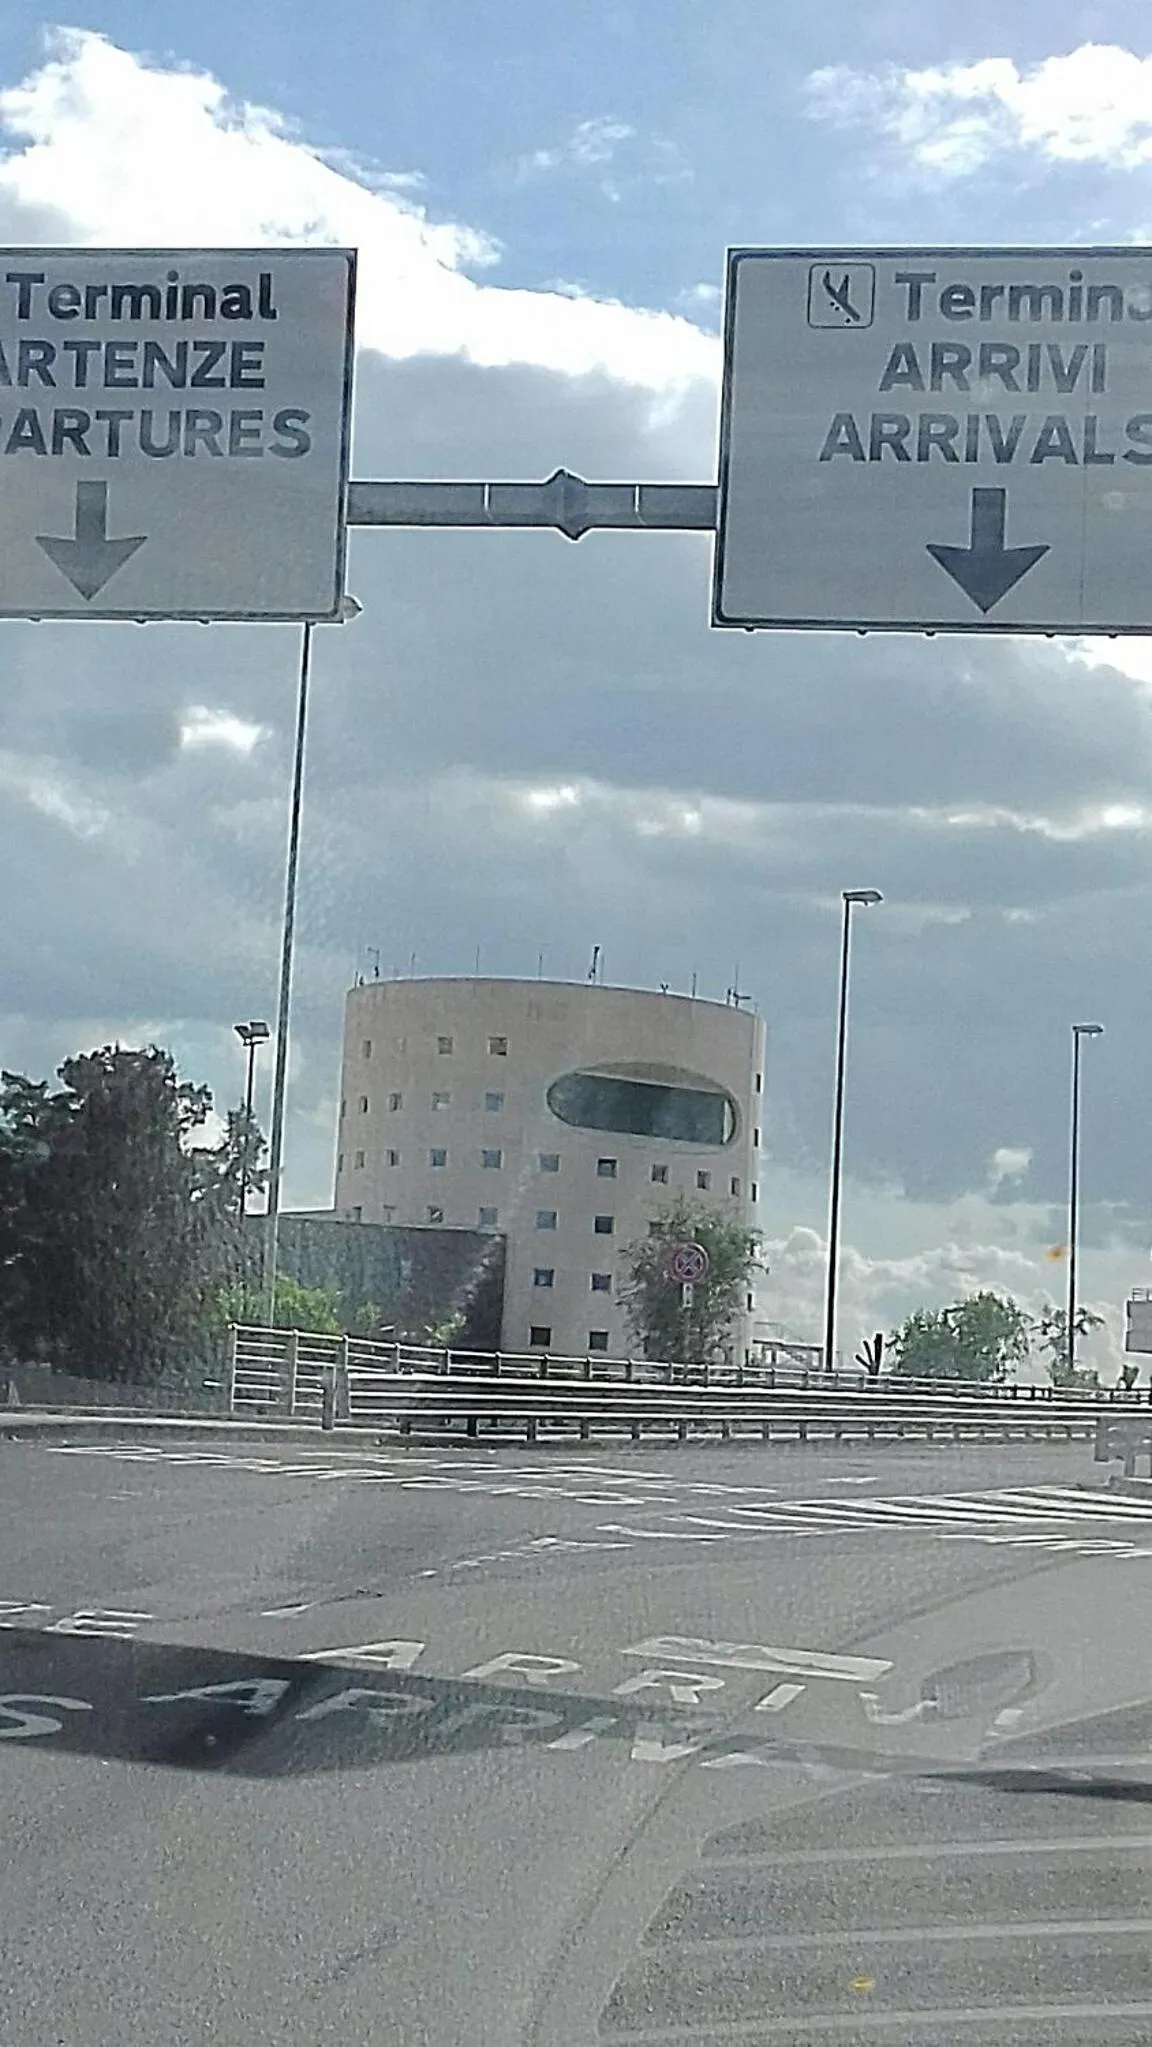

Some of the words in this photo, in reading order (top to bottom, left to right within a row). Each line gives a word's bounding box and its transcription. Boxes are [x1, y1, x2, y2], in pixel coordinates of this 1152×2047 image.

[6, 270, 277, 320] Terminal
[878, 342, 1107, 394] ARRIVI
[819, 412, 1152, 465] ARRIVALS
